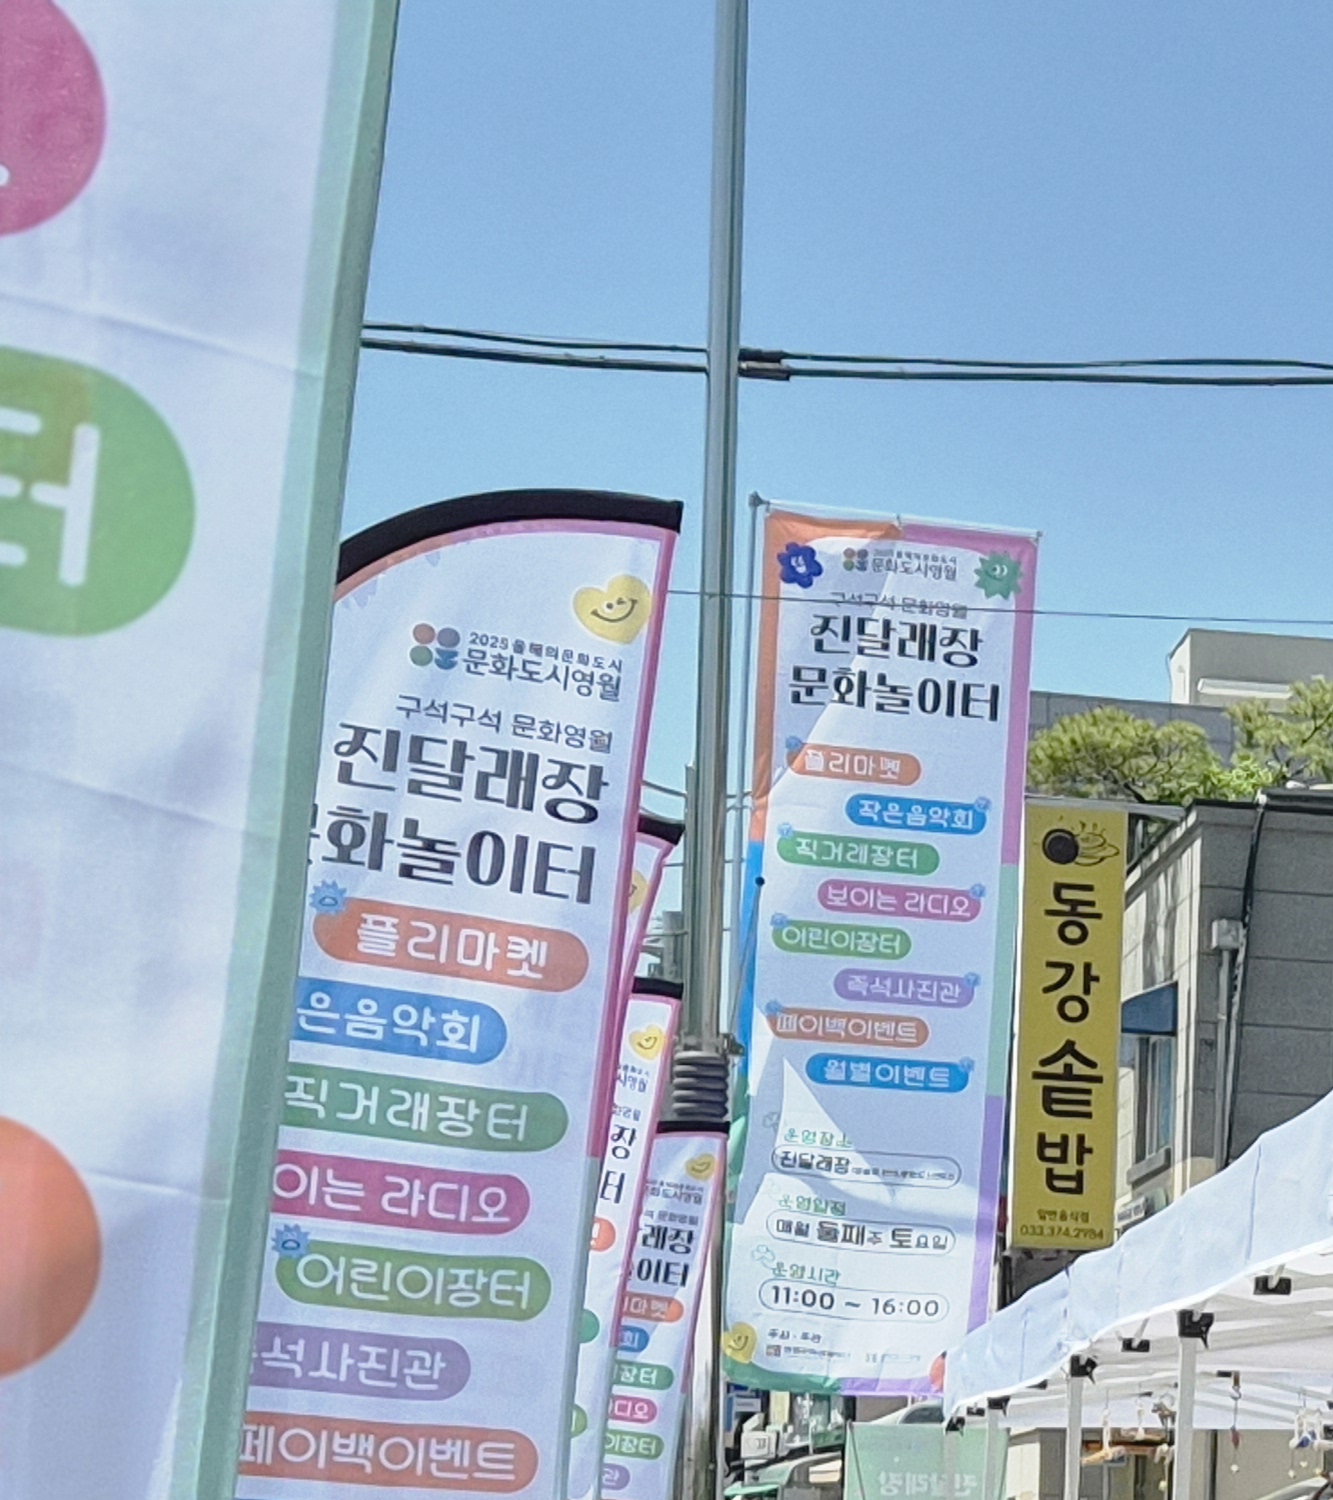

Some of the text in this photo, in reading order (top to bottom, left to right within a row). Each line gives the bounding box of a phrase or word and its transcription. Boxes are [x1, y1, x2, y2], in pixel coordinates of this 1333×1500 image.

[469, 631, 509, 650] 2025
[810, 614, 984, 668] 진달래장
[463, 647, 621, 702] 문화도시영월
[789, 664, 1000, 722] 문화놀이터
[396, 694, 613, 754] 구석구석 문화영월
[333, 722, 610, 824] 진달래장
[804, 750, 901, 779] 플리마켓
[859, 799, 974, 830] 작은음악회
[796, 837, 918, 869] 직거래장터
[827, 885, 971, 917] 보이는 라디오
[356, 912, 548, 979] 플리마켓
[781, 926, 901, 955] 어린이장터
[847, 974, 961, 1004] 즉석사진관
[776, 1013, 917, 1043] 페이백이벤트
[1031, 881, 1104, 1195] 동강솥밥
[823, 1059, 950, 1088] 월별이벤트
[284, 1074, 528, 1142] 직거래장터
[780, 1150, 850, 1174] 진달래장
[381, 1175, 511, 1224] 라디오
[889, 1228, 948, 1250] 토요일
[295, 1253, 532, 1310] 어린이장터
[772, 1285, 835, 1310] 11:00
[872, 1297, 939, 1316] 16:00
[250, 1337, 447, 1390] 석사진관
[240, 1424, 515, 1481] 페이백이벤트
